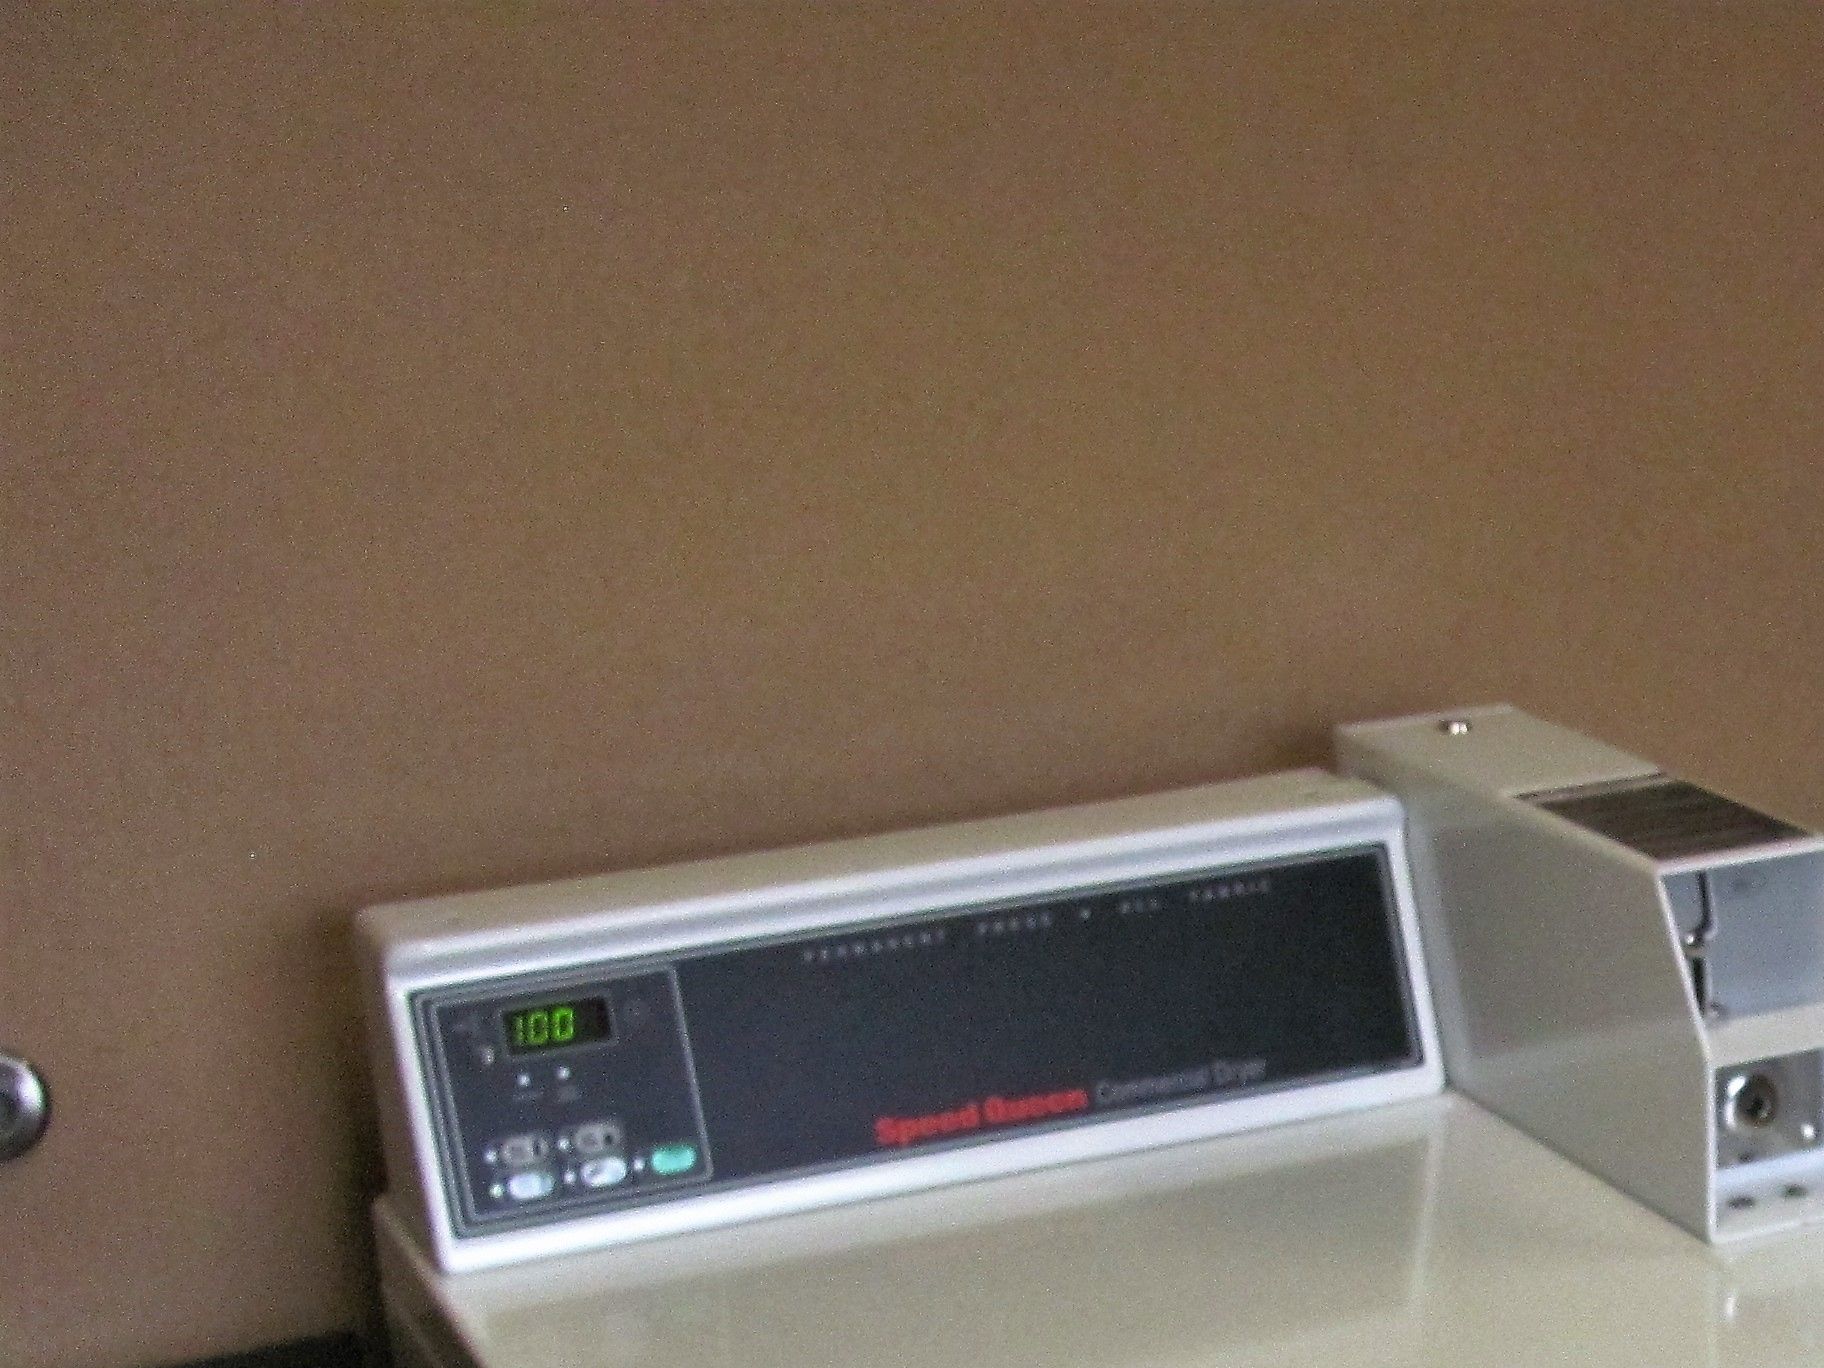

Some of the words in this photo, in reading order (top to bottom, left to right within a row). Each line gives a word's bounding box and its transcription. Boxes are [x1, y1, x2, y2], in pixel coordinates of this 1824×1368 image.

[514, 1006, 575, 1045] 100
[875, 1104, 980, 1146] Speed
[984, 1087, 1089, 1124] Queen
[1212, 1057, 1268, 1088] Dryer
